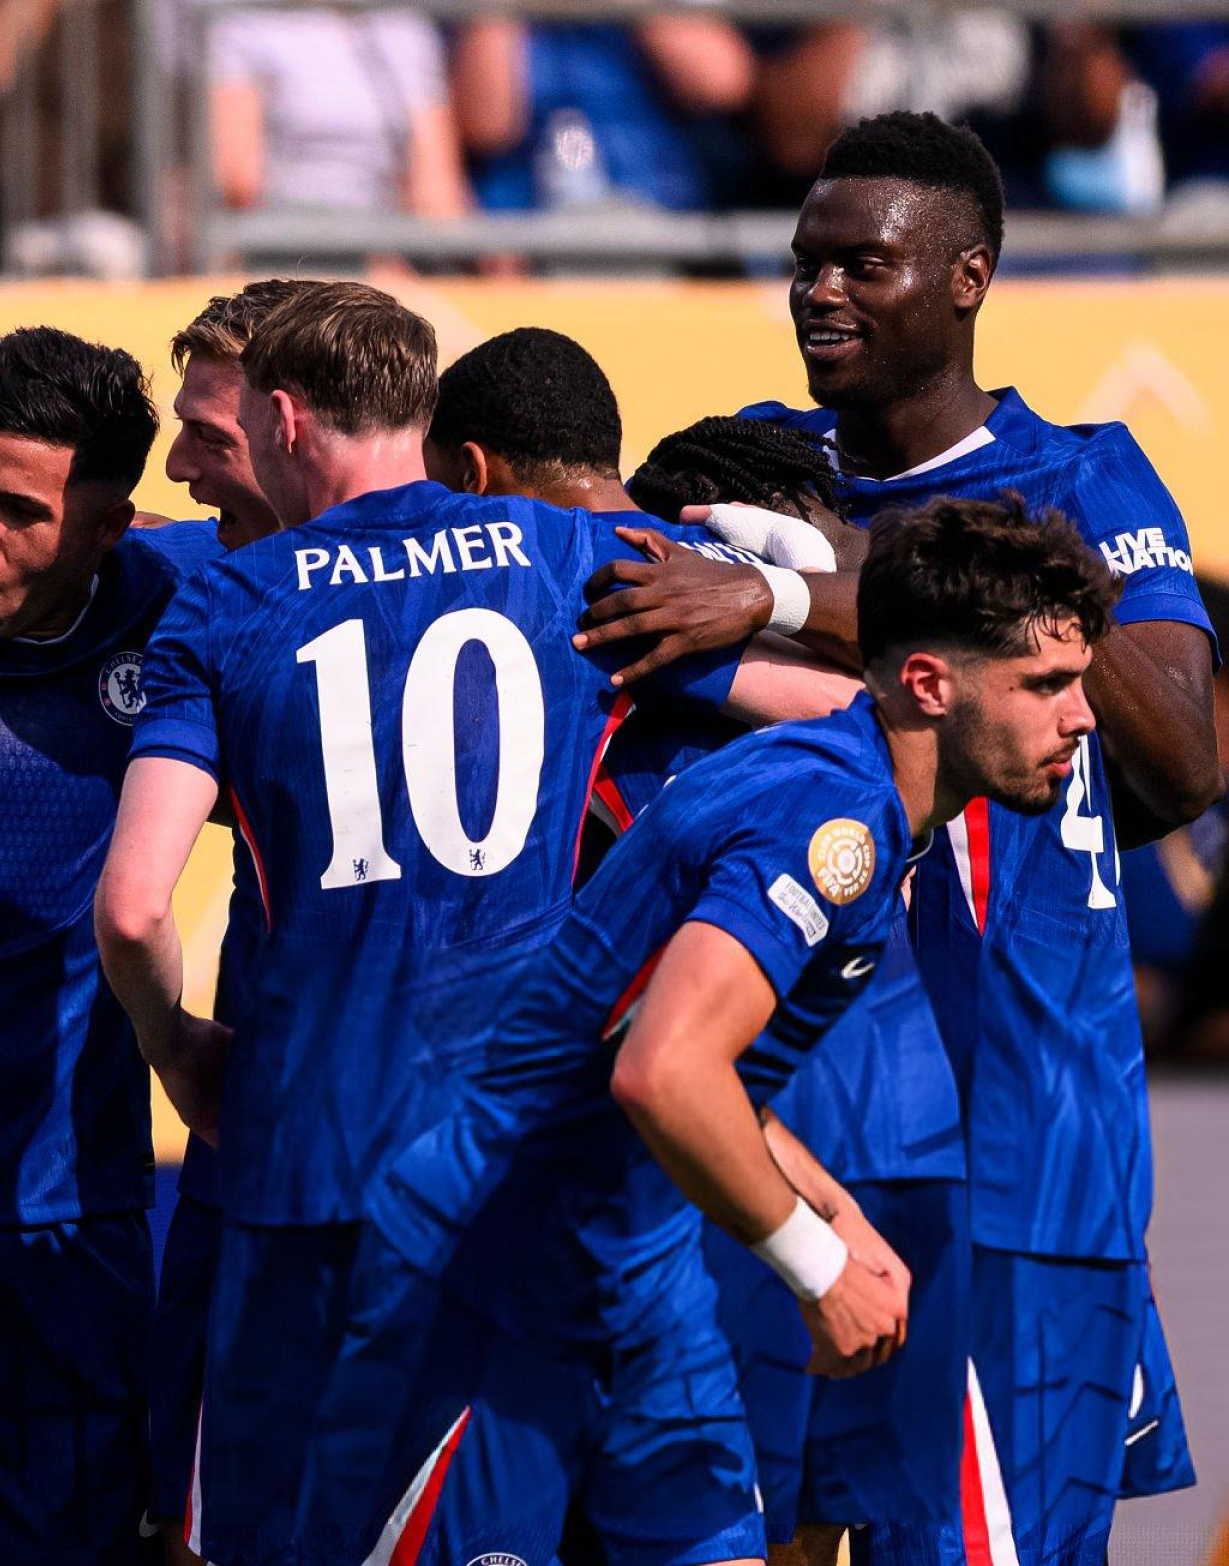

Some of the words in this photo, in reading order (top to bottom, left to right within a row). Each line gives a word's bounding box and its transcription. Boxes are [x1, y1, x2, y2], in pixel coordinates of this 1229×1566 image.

[294, 521, 532, 591] PALMER
[1098, 527, 1166, 561] LIVE
[295, 607, 546, 890] 10
